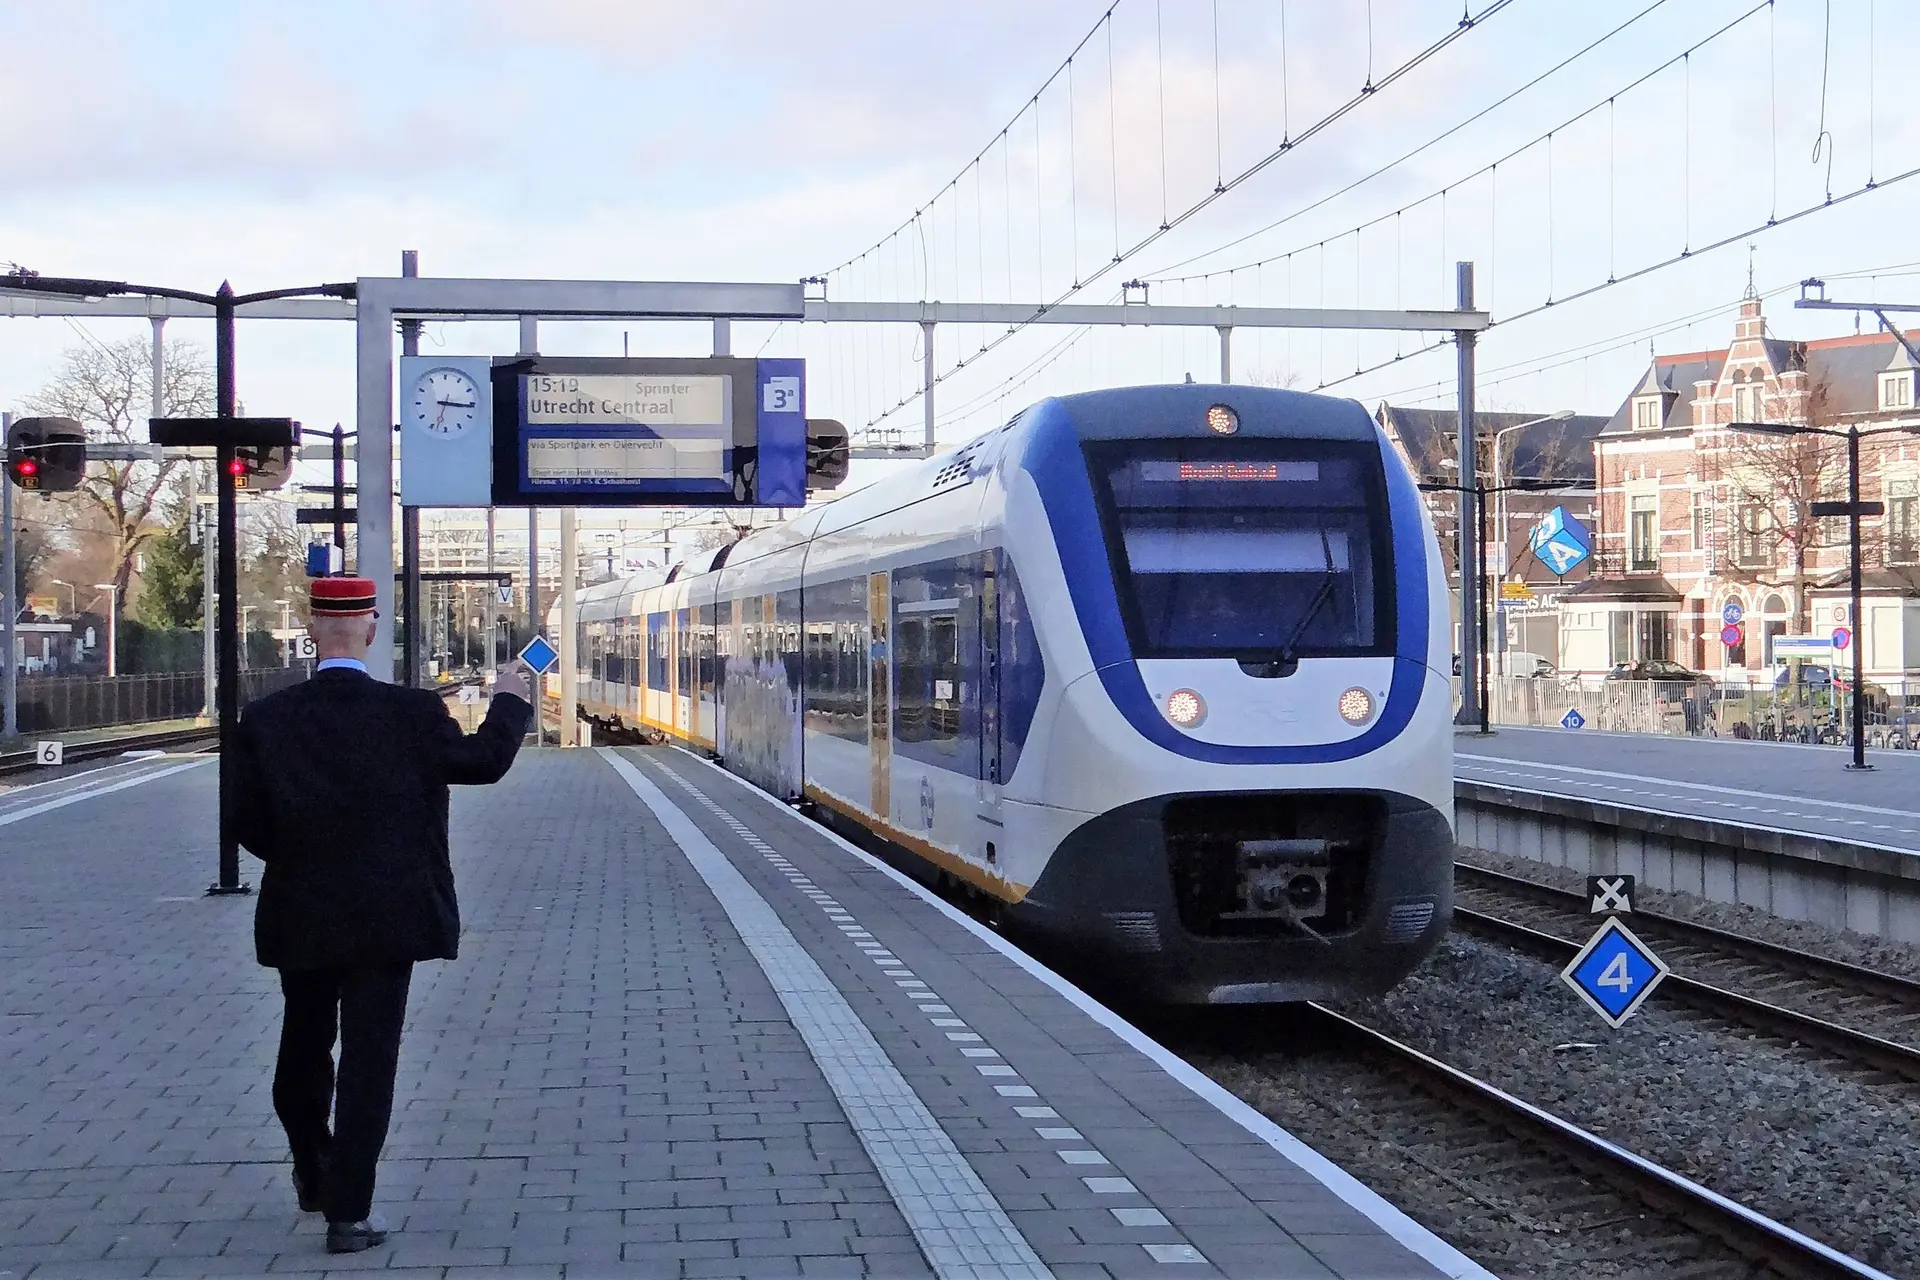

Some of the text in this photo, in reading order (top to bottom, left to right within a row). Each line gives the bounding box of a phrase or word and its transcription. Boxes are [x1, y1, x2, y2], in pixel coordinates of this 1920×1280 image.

[532, 377, 579, 393] 15:19
[635, 382, 691, 397] Sprinter
[531, 398, 674, 414] Utrecht Centraal
[531, 440, 663, 450] via Sportpark en Overvecht
[302, 637, 314, 655] 8
[1566, 716, 1579, 728] 10
[43, 743, 57, 762] 6
[1597, 952, 1634, 993] 4
